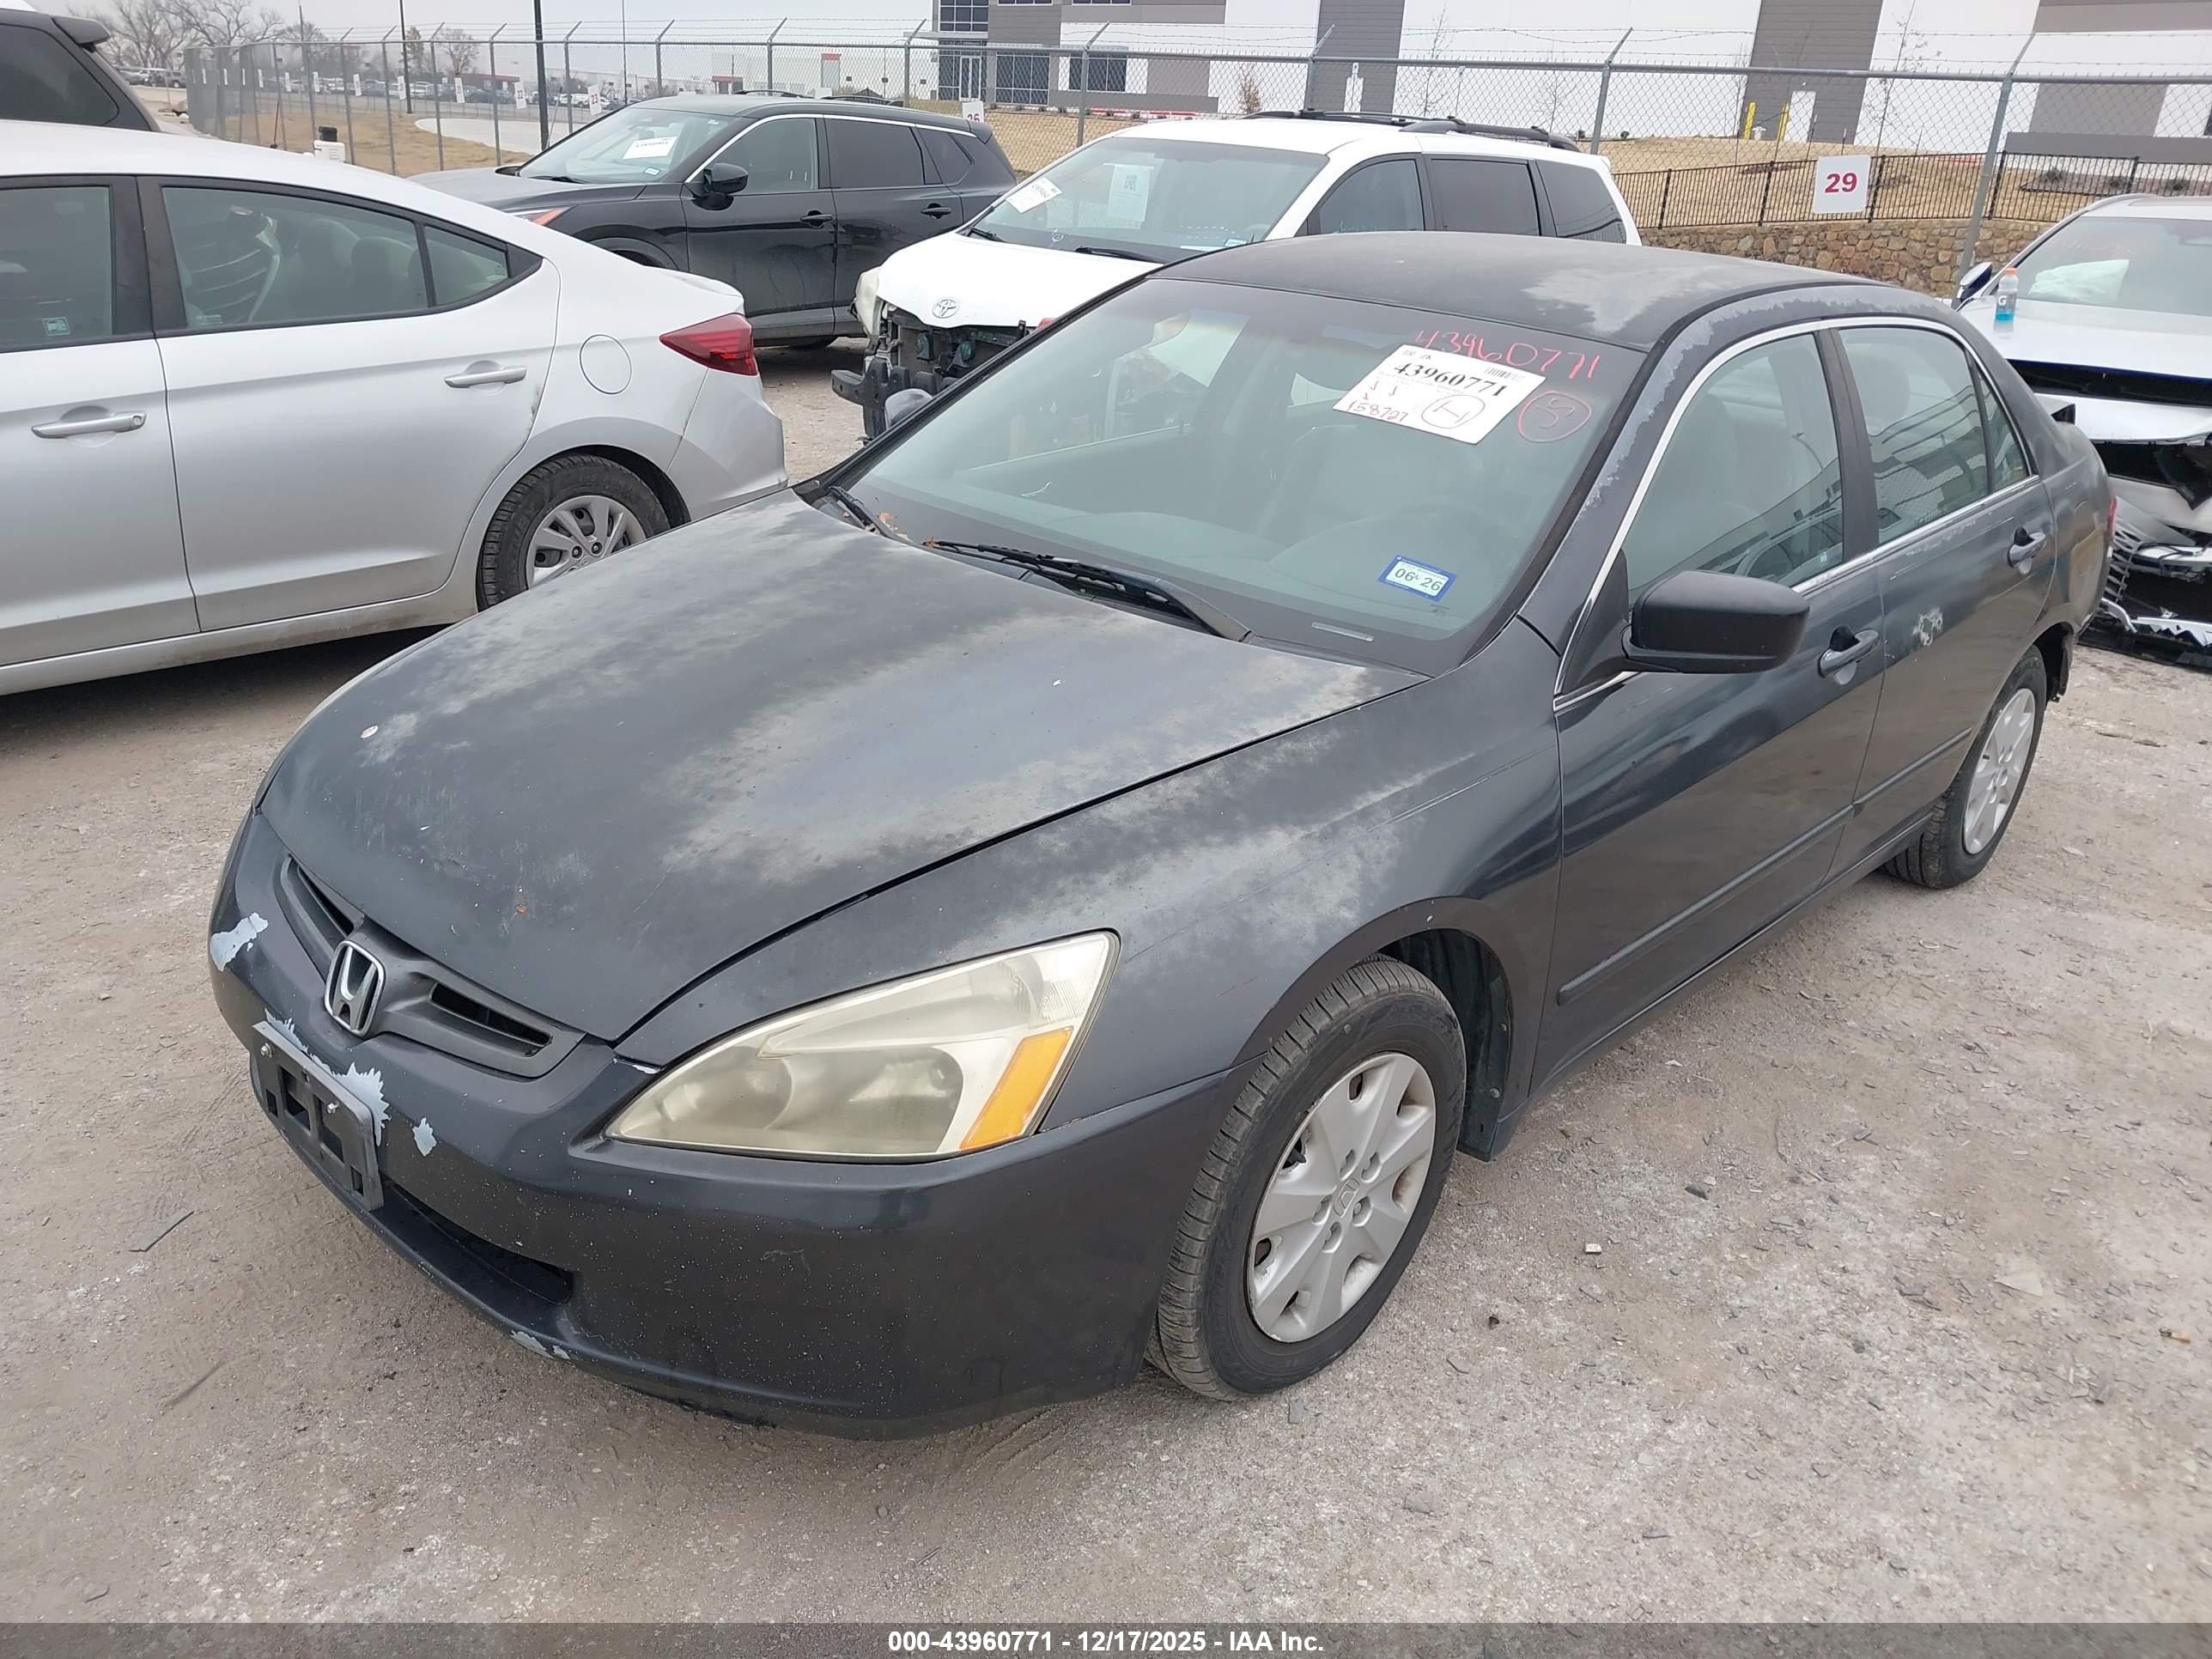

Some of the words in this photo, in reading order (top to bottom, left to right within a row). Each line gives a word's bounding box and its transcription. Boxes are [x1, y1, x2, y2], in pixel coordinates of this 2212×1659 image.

[1825, 173, 1858, 193] 29
[1415, 331, 1600, 379] 43960771
[1395, 362, 1507, 397] 43960771
[1395, 568, 1416, 581] 06
[1420, 577, 1443, 591] 26
